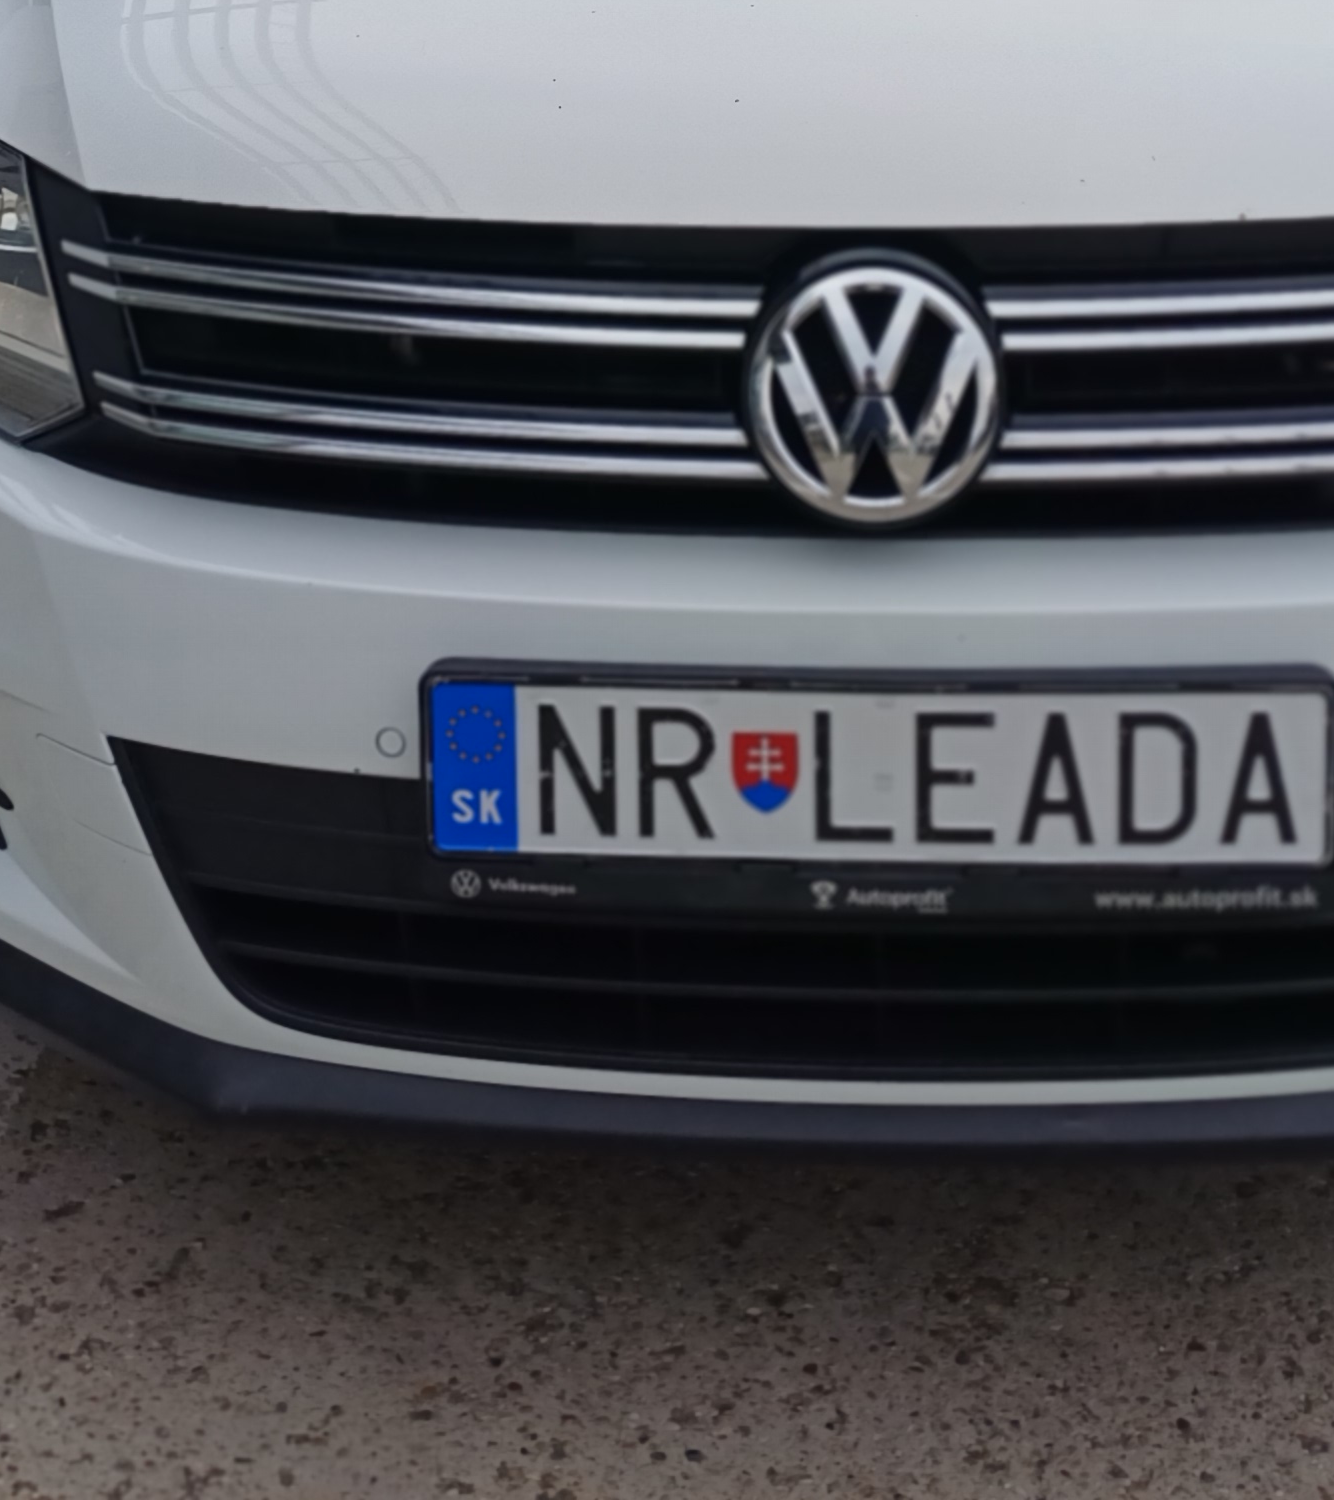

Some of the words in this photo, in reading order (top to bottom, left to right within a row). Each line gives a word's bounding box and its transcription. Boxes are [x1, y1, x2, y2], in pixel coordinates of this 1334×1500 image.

[537, 704, 716, 838] NR
[813, 711, 1297, 845] LEADA
[451, 789, 503, 825] SK
[1095, 885, 1317, 911] www.autoprofit.sk
